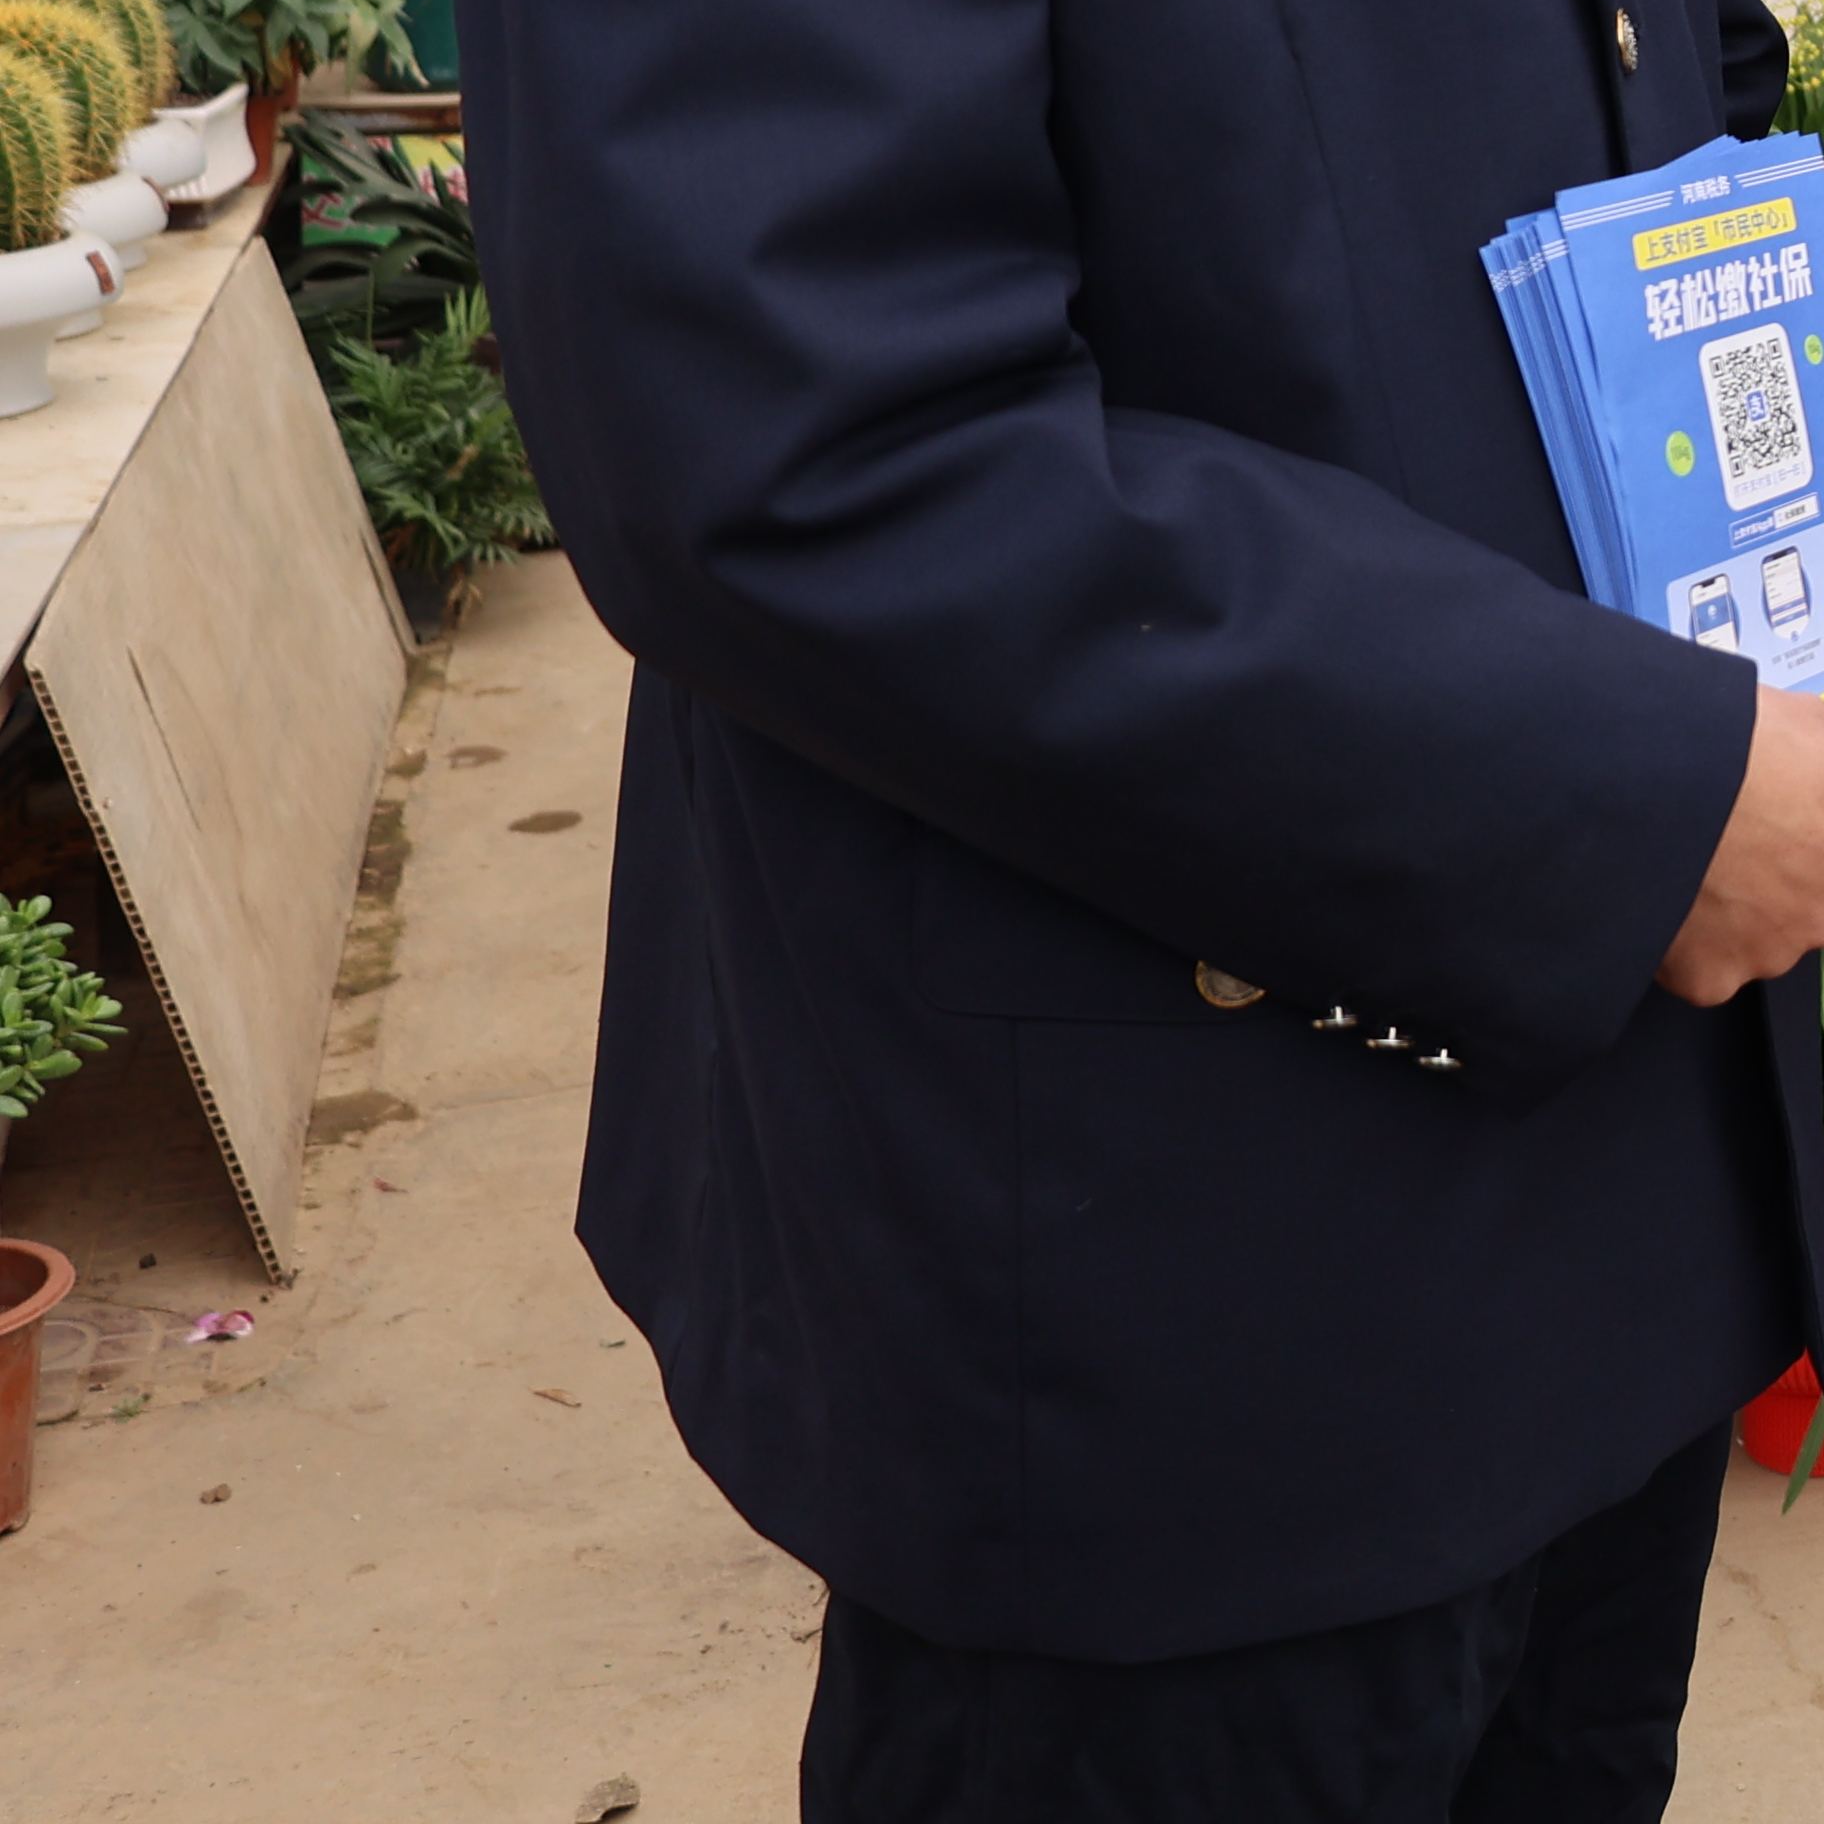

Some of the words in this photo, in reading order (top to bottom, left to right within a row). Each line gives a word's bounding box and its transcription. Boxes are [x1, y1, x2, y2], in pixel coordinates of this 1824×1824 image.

[1680, 176, 1731, 205] 河南税务
[1645, 243, 1813, 341] 轻松缴社保
